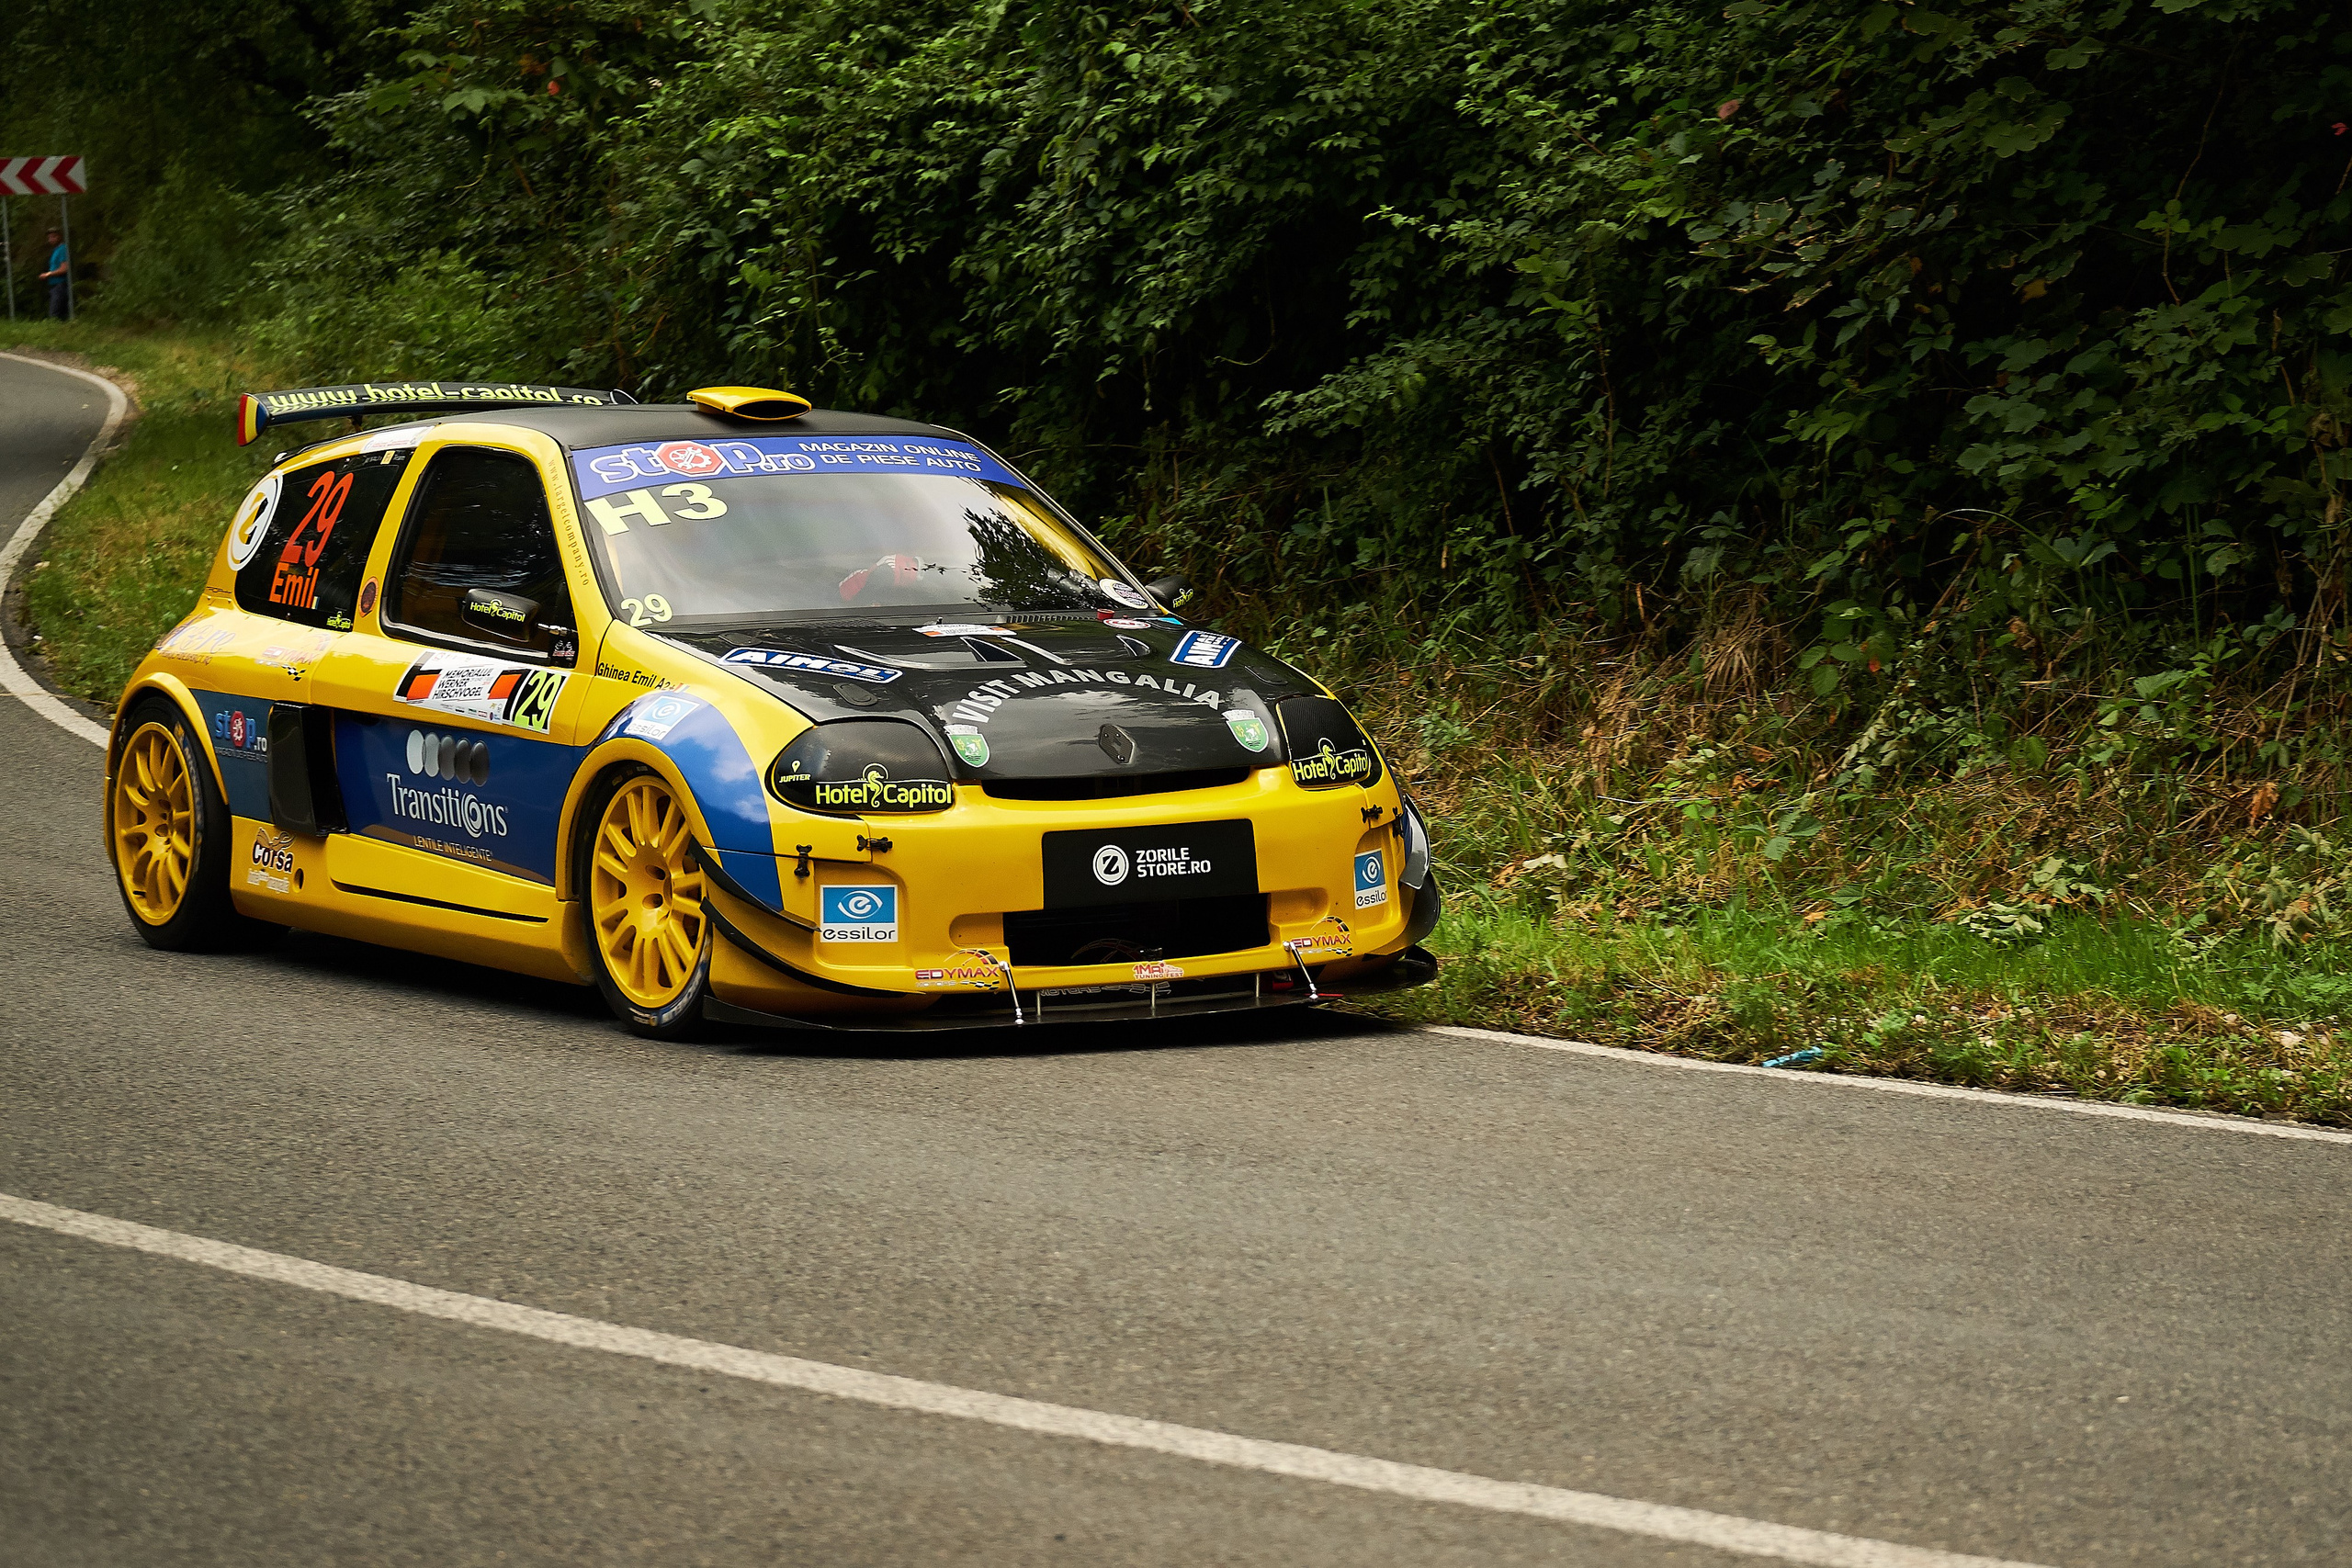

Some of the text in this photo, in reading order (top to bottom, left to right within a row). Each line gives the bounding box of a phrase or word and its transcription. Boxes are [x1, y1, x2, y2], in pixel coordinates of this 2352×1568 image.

[798, 443, 981, 463] MAGAZIN ONLINE
[820, 454, 982, 472] DE PIESE AUTO
[280, 470, 354, 568] 29
[584, 482, 729, 536] H3
[548, 459, 589, 586] www.targetcompany.ro
[268, 561, 320, 609] Emil
[470, 602, 526, 622] Hotel Capitol
[620, 593, 673, 626] 29
[438, 679, 469, 689] WERNER
[597, 662, 630, 682] Ghinea
[631, 671, 657, 688] Emil
[433, 687, 483, 699] HIRSCHVOGEL
[514, 671, 561, 731] 29
[952, 669, 1223, 724] VISIT MANGALIA
[627, 722, 667, 738] essilor
[779, 773, 810, 783] JUPITER
[1292, 752, 1368, 781] Hotel Capitol
[387, 773, 508, 838] Transitions
[816, 783, 952, 807] Hotel Capitol
[252, 840, 294, 874] Corsa
[413, 835, 492, 862] LENTILE INTELIGENTE
[1136, 847, 1190, 863] ZORILE
[1136, 860, 1211, 877] STORE.RO
[822, 927, 896, 940] essilor
[1291, 933, 1352, 948] EDYMAX
[915, 967, 1000, 980] EDYMAX
